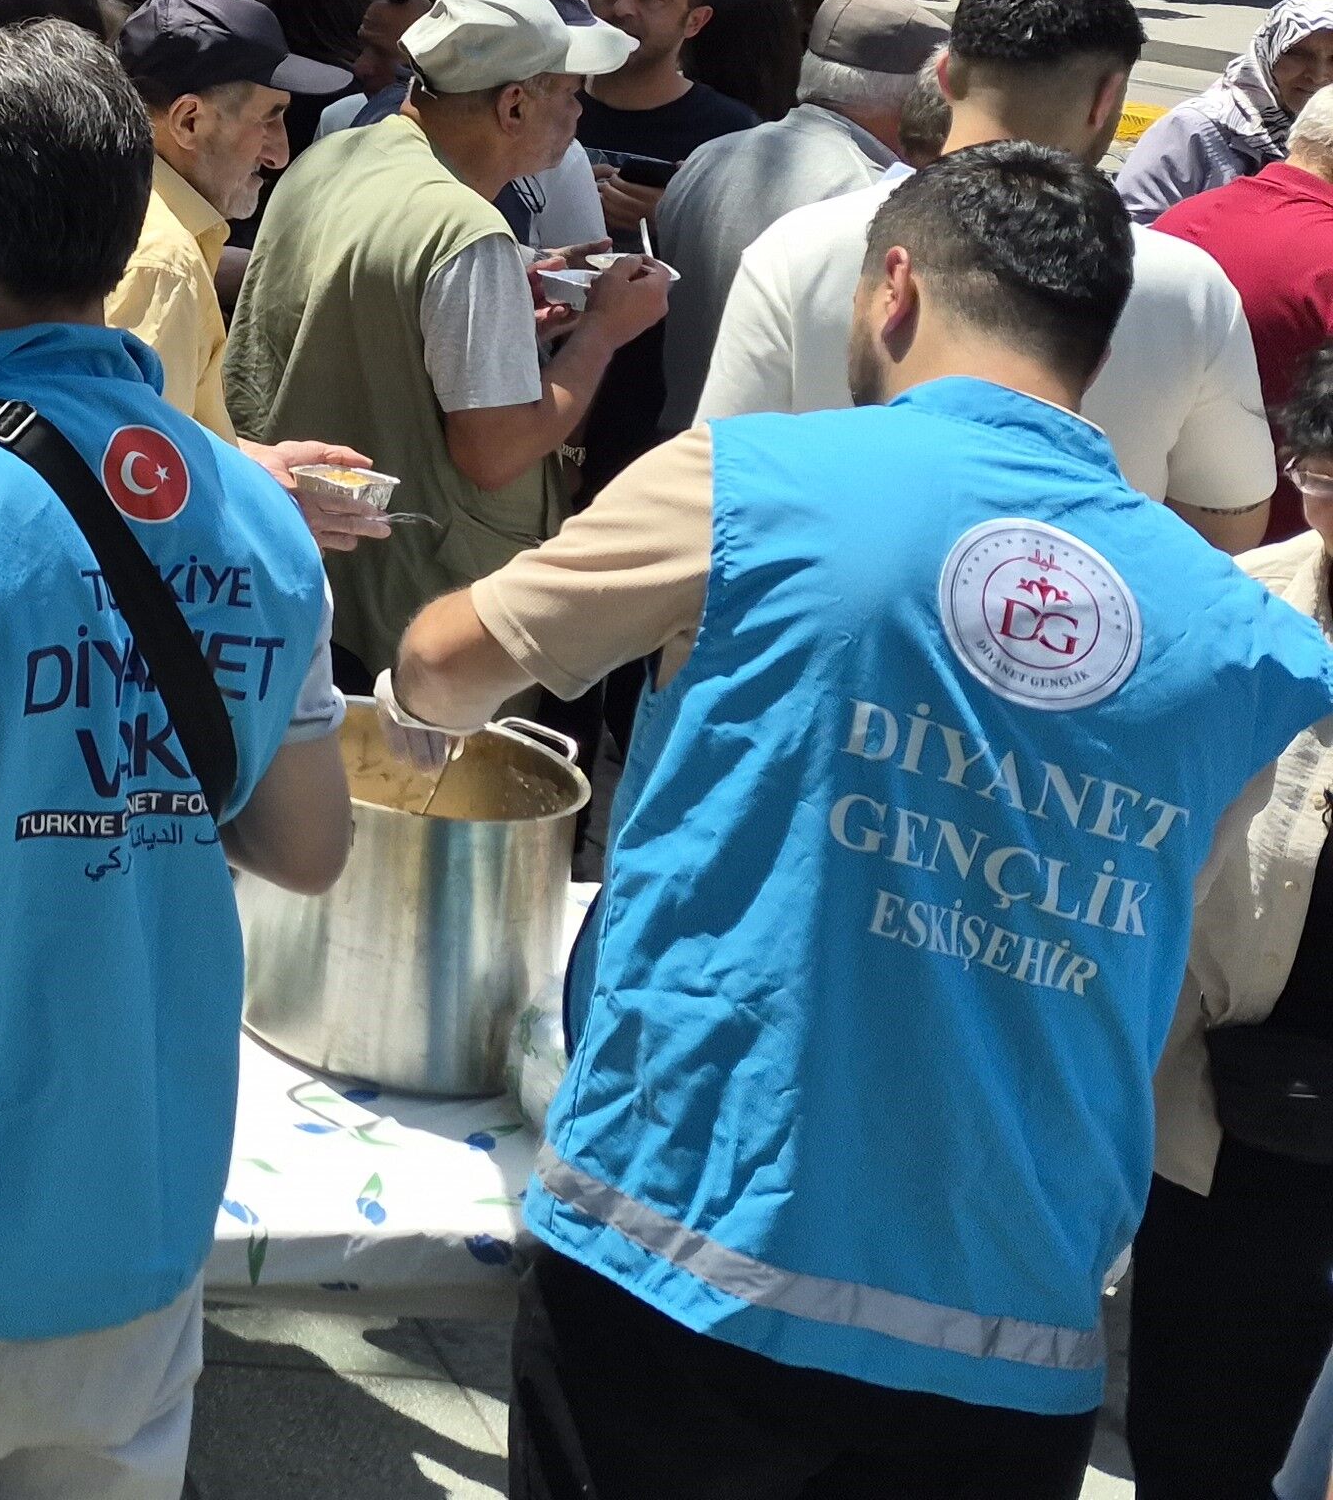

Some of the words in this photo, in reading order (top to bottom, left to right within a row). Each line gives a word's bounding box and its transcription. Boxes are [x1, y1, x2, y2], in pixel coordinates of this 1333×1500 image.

[81, 554, 252, 612] TKİYE
[23, 624, 285, 717] DİYAET
[976, 638, 1028, 683] DİYANET
[1029, 668, 1090, 690] GENÇLİK
[840, 697, 1191, 852] DİYANET
[19, 814, 115, 836] TURKIYE
[829, 793, 1152, 937] GENÇLİK
[868, 888, 1099, 996] ESKİŞEHİR
